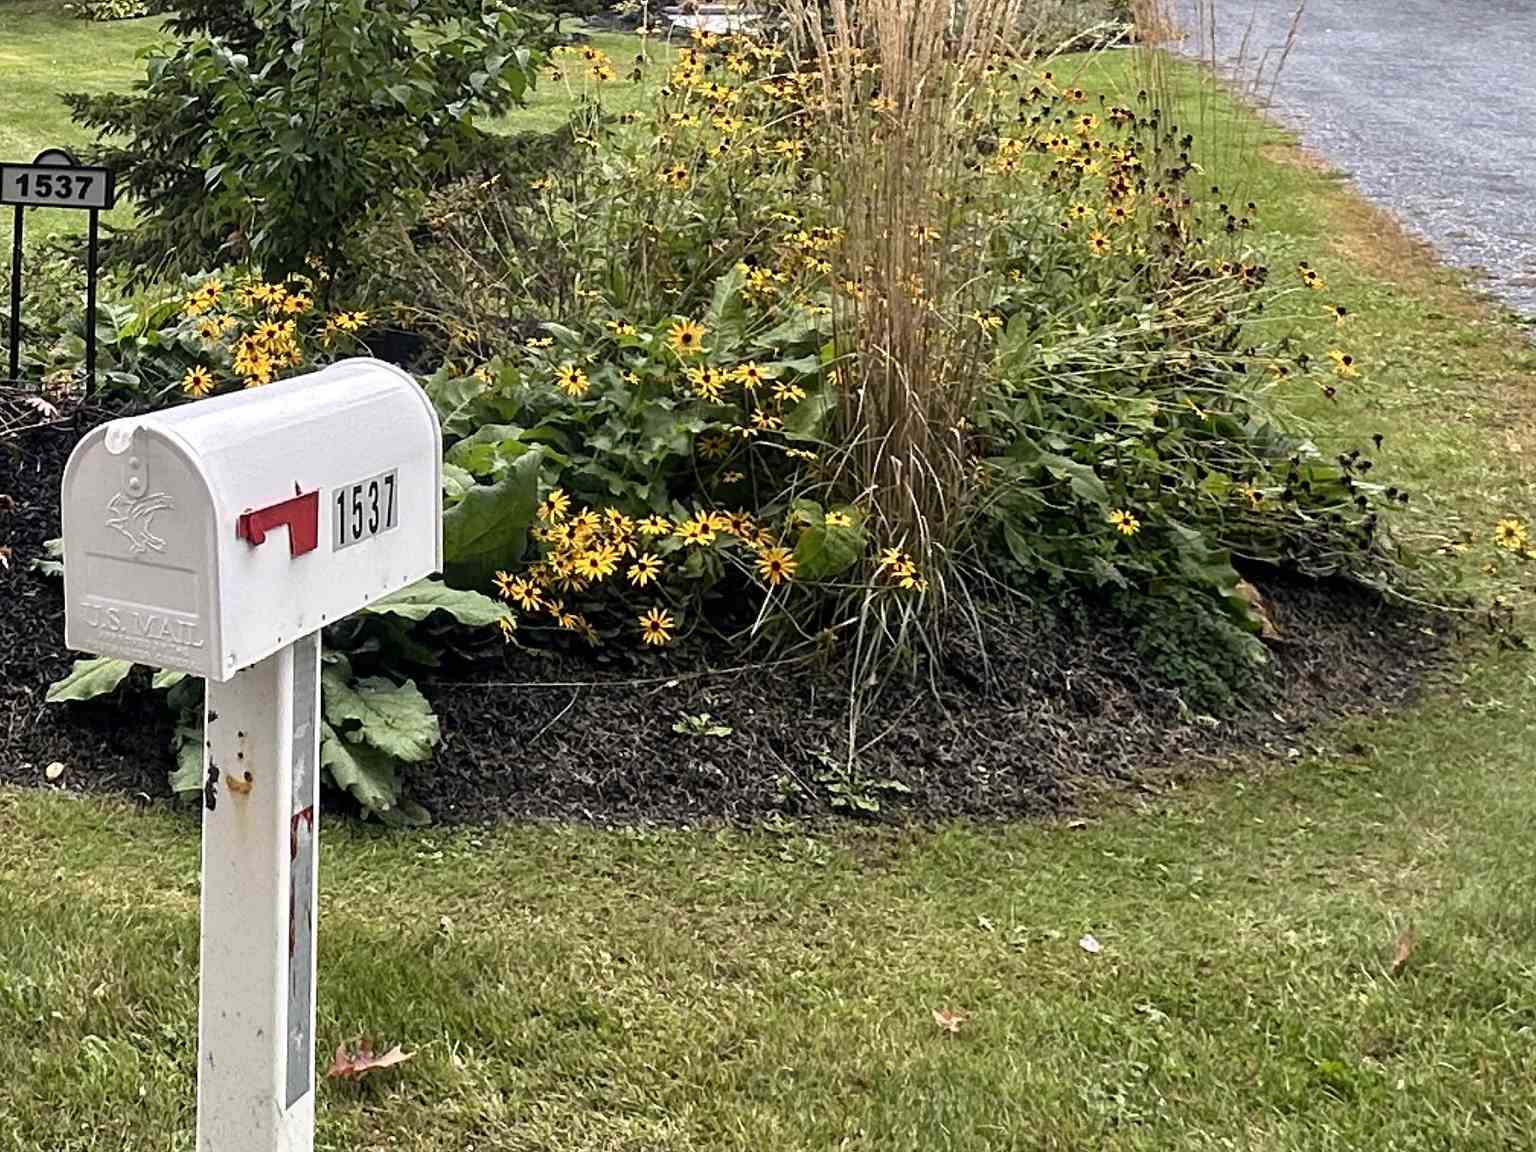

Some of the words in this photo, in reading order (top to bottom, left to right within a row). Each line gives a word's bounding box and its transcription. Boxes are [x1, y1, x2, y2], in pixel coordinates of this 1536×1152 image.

[15, 173, 94, 200] 1537
[337, 474, 394, 544] 1537
[128, 611, 204, 649] MAIL
